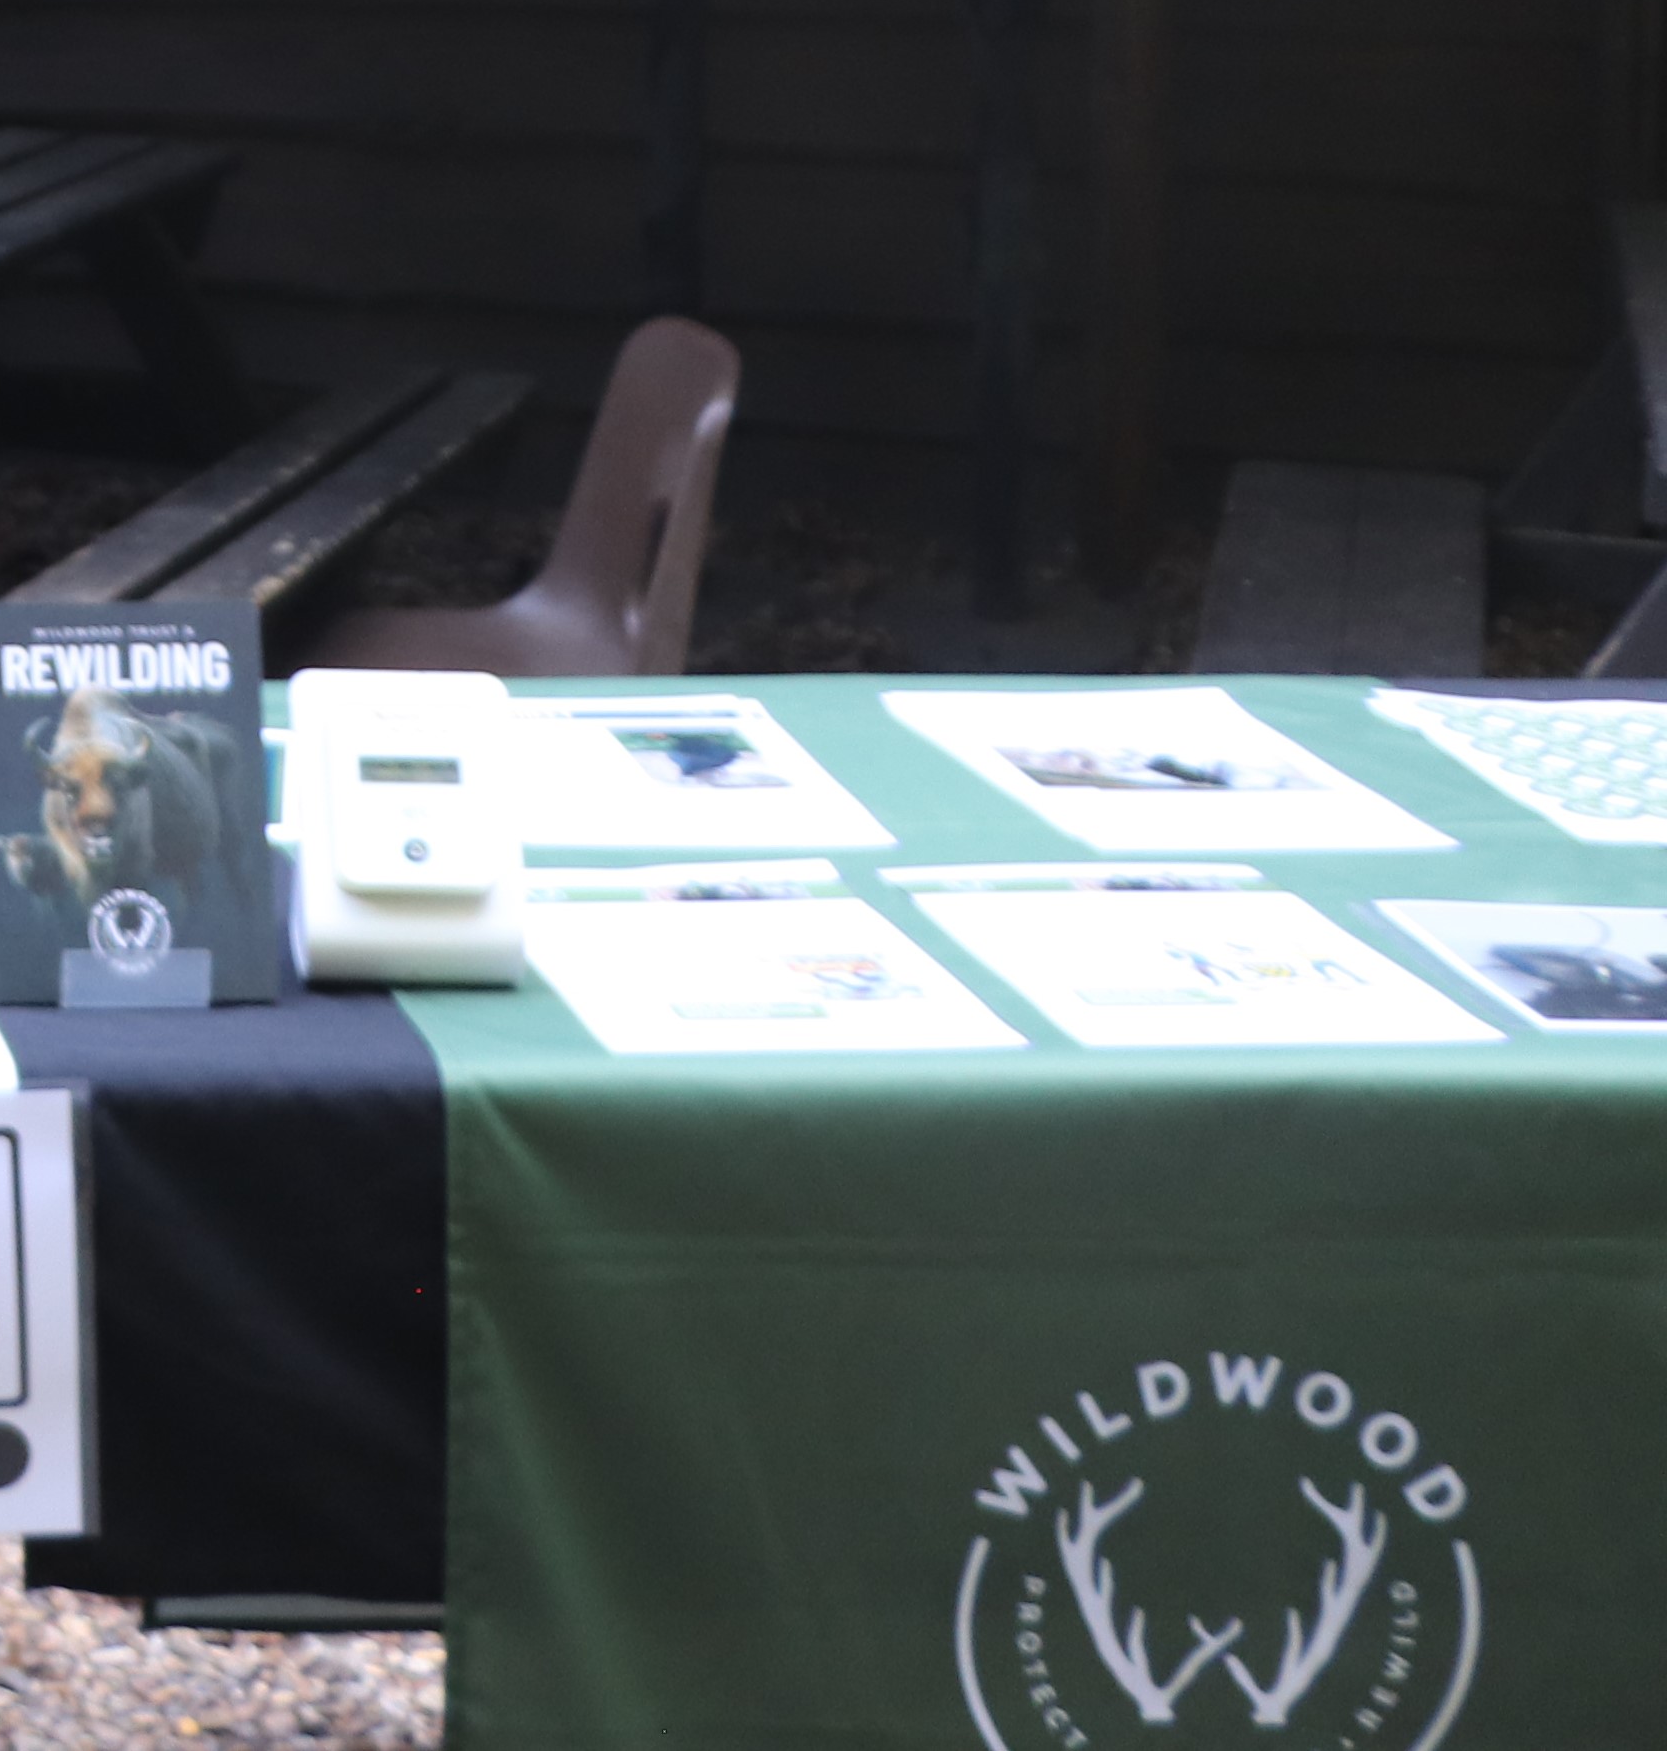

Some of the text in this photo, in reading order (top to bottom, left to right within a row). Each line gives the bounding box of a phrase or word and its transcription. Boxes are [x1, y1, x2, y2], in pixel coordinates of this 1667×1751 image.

[1, 641, 232, 693] REWILDING
[973, 1350, 1468, 1523] WILDWOOD
[1015, 1573, 1088, 1749] PROTECT
